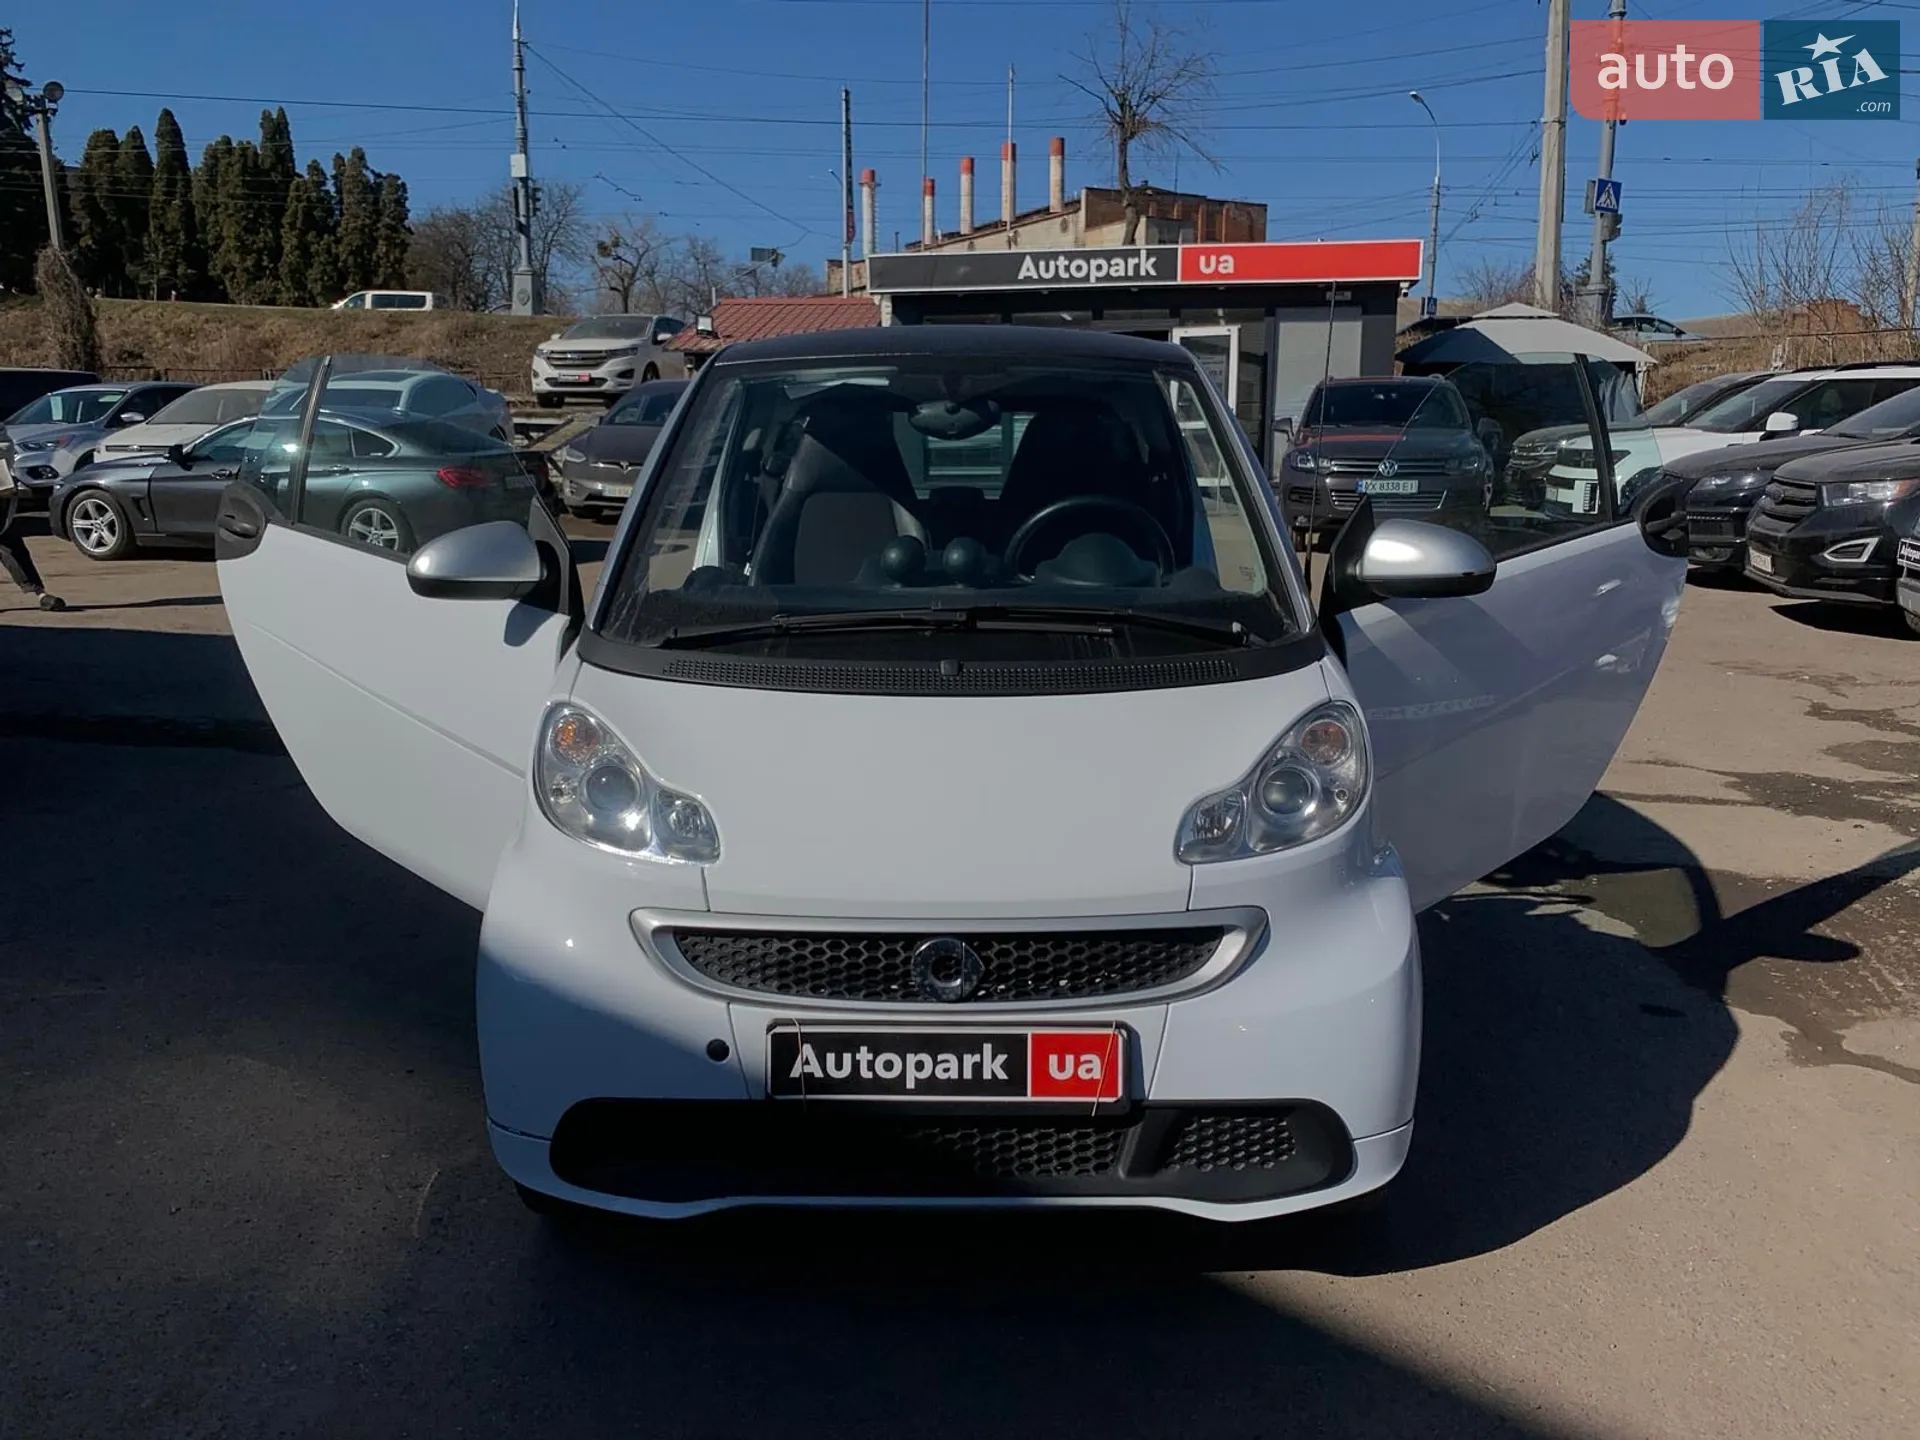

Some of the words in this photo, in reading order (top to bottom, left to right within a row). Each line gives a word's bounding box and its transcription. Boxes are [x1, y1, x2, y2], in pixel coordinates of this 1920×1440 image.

[1017, 249, 1157, 283] Autopark
[1199, 253, 1235, 275] ua
[789, 1043, 1009, 1089] Autopark
[1048, 1053, 1101, 1080] ua
